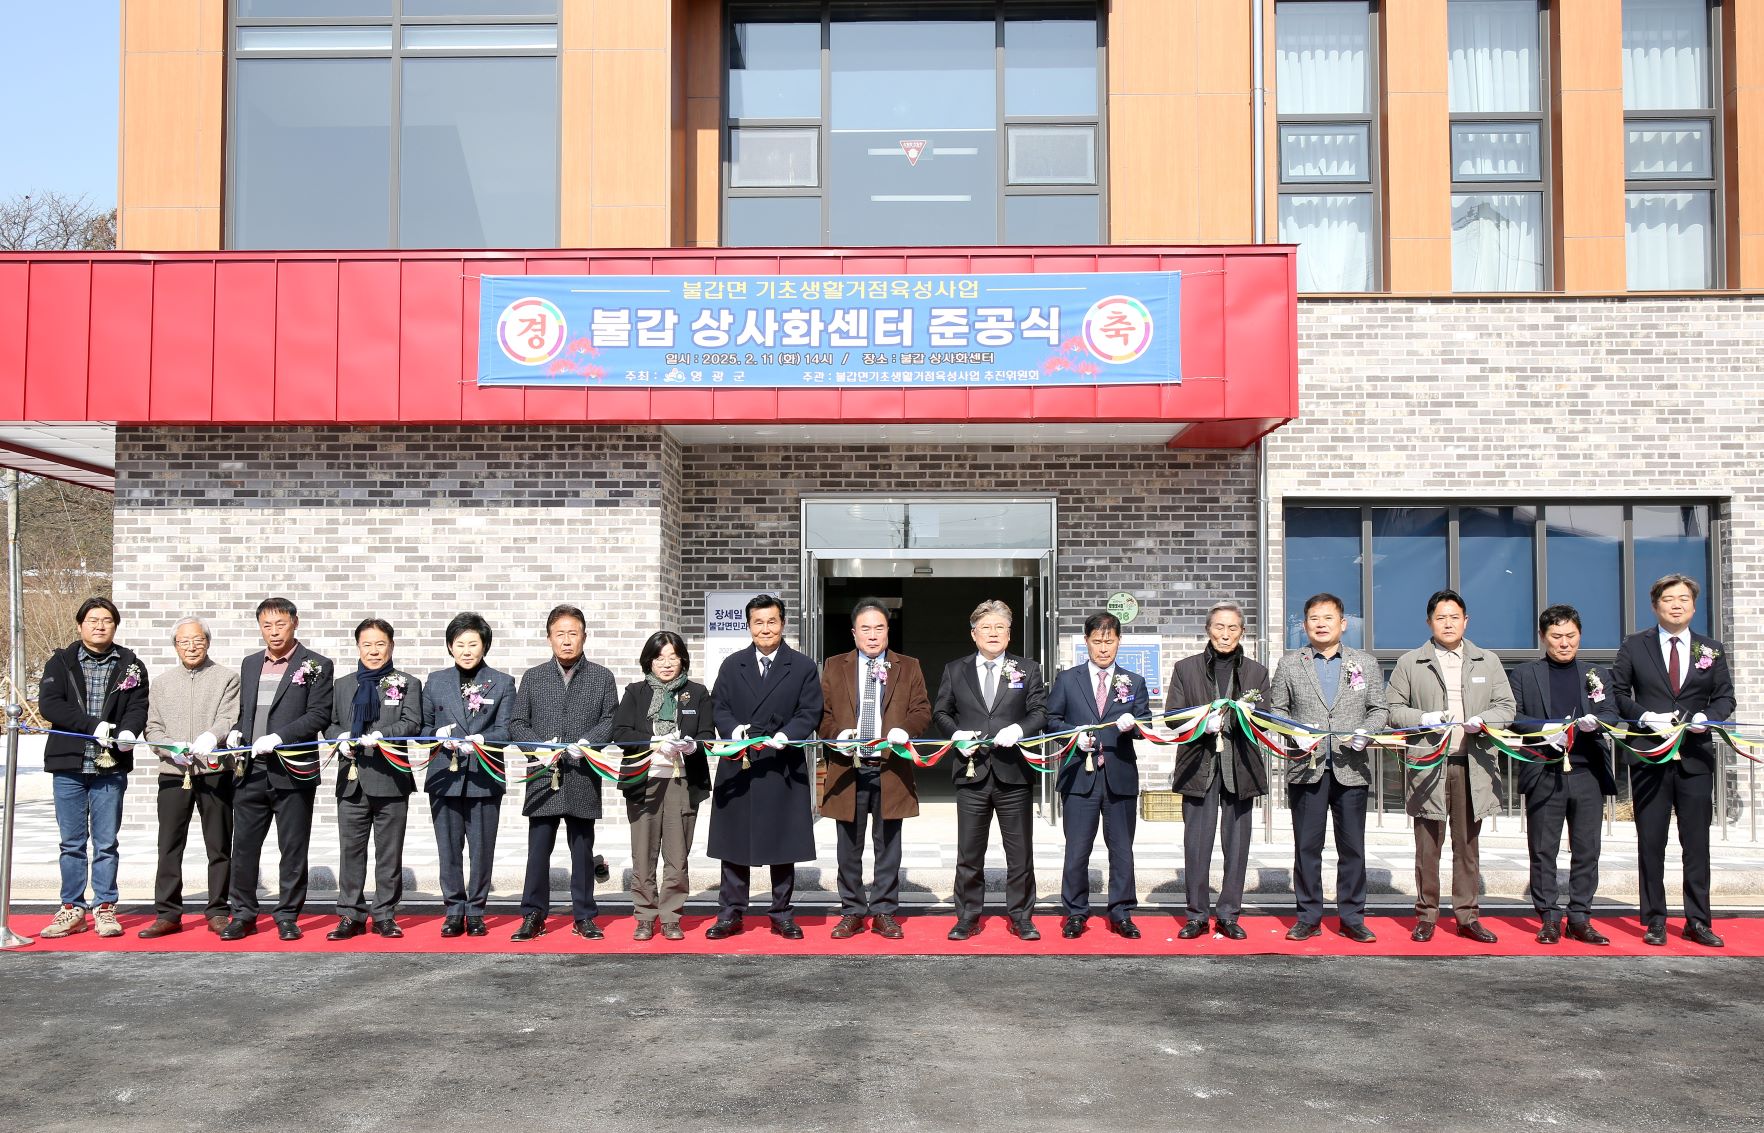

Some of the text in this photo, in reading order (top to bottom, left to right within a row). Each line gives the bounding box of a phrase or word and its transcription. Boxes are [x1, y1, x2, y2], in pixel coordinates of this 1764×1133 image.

[682, 279, 979, 300] 불갑면 기초생활거점육성사업
[516, 313, 548, 350] 경
[591, 305, 1061, 348] 불갑 상사화센터 준공식
[1099, 310, 1136, 347] 축
[702, 353, 741, 365] 2025.
[745, 353, 758, 365] 2.
[761, 353, 774, 365] 11
[804, 353, 833, 365] 14시
[900, 353, 925, 364] 불갑
[929, 352, 995, 364] 상사화센터
[836, 370, 980, 383] 불갑면기초생활거점육성사업
[984, 369, 1040, 382] 추진위원회
[715, 609, 742, 620] 장세일
